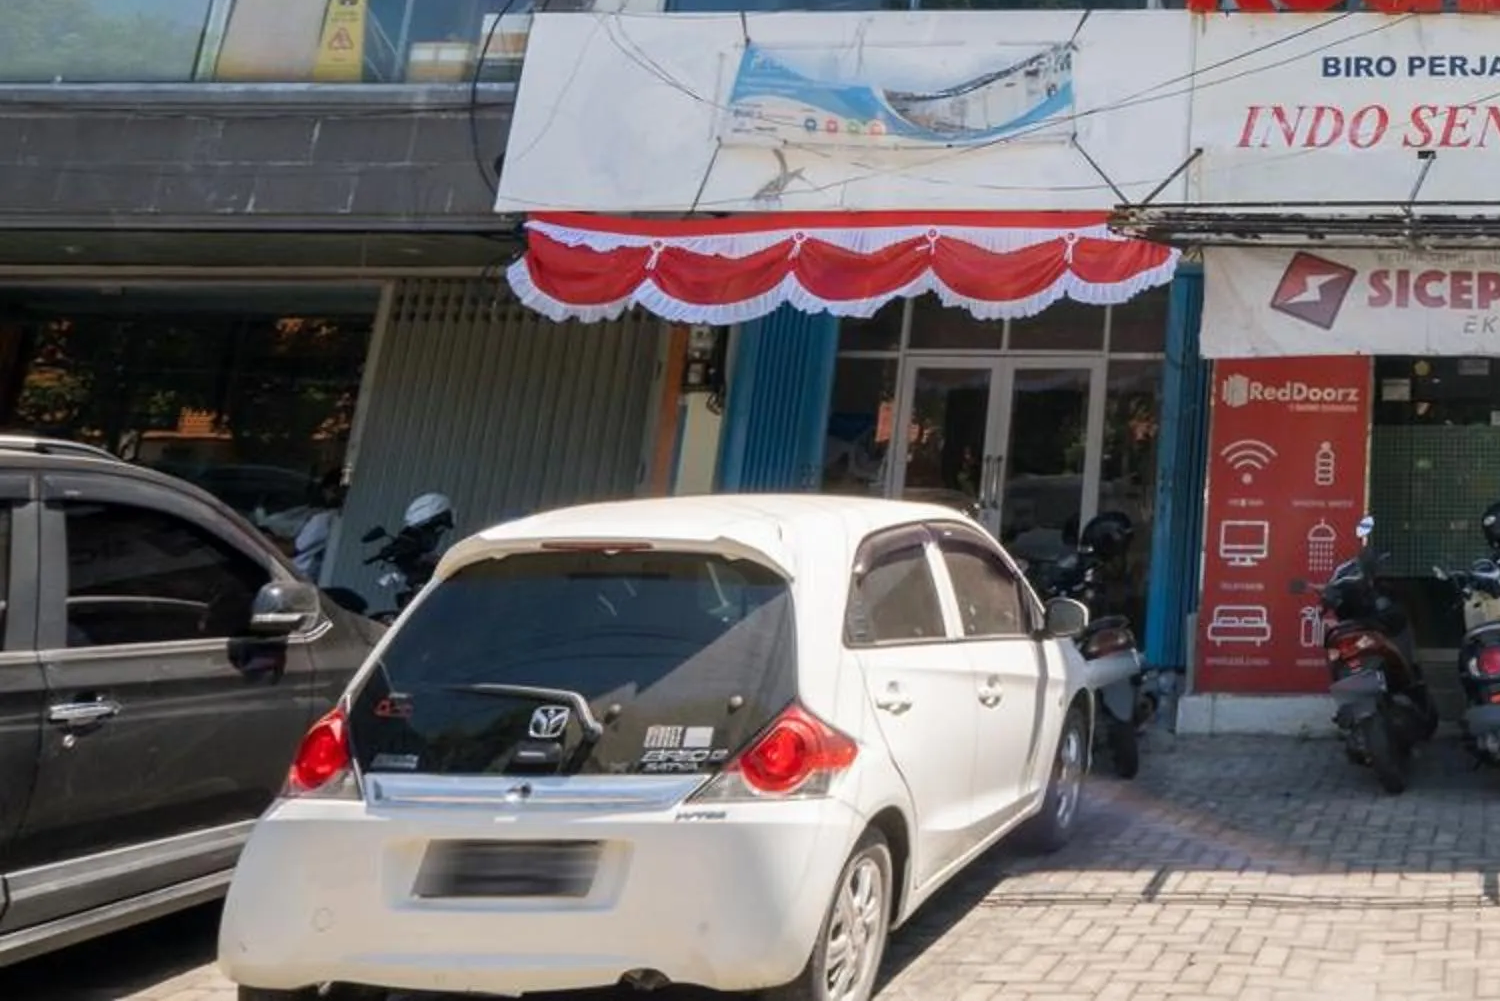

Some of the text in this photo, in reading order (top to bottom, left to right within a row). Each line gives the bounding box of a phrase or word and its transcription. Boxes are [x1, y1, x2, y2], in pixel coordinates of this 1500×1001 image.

[1321, 55, 1398, 79] BIRO
[1237, 104, 1390, 150] INDO
[1250, 381, 1360, 402] RedDoorz
